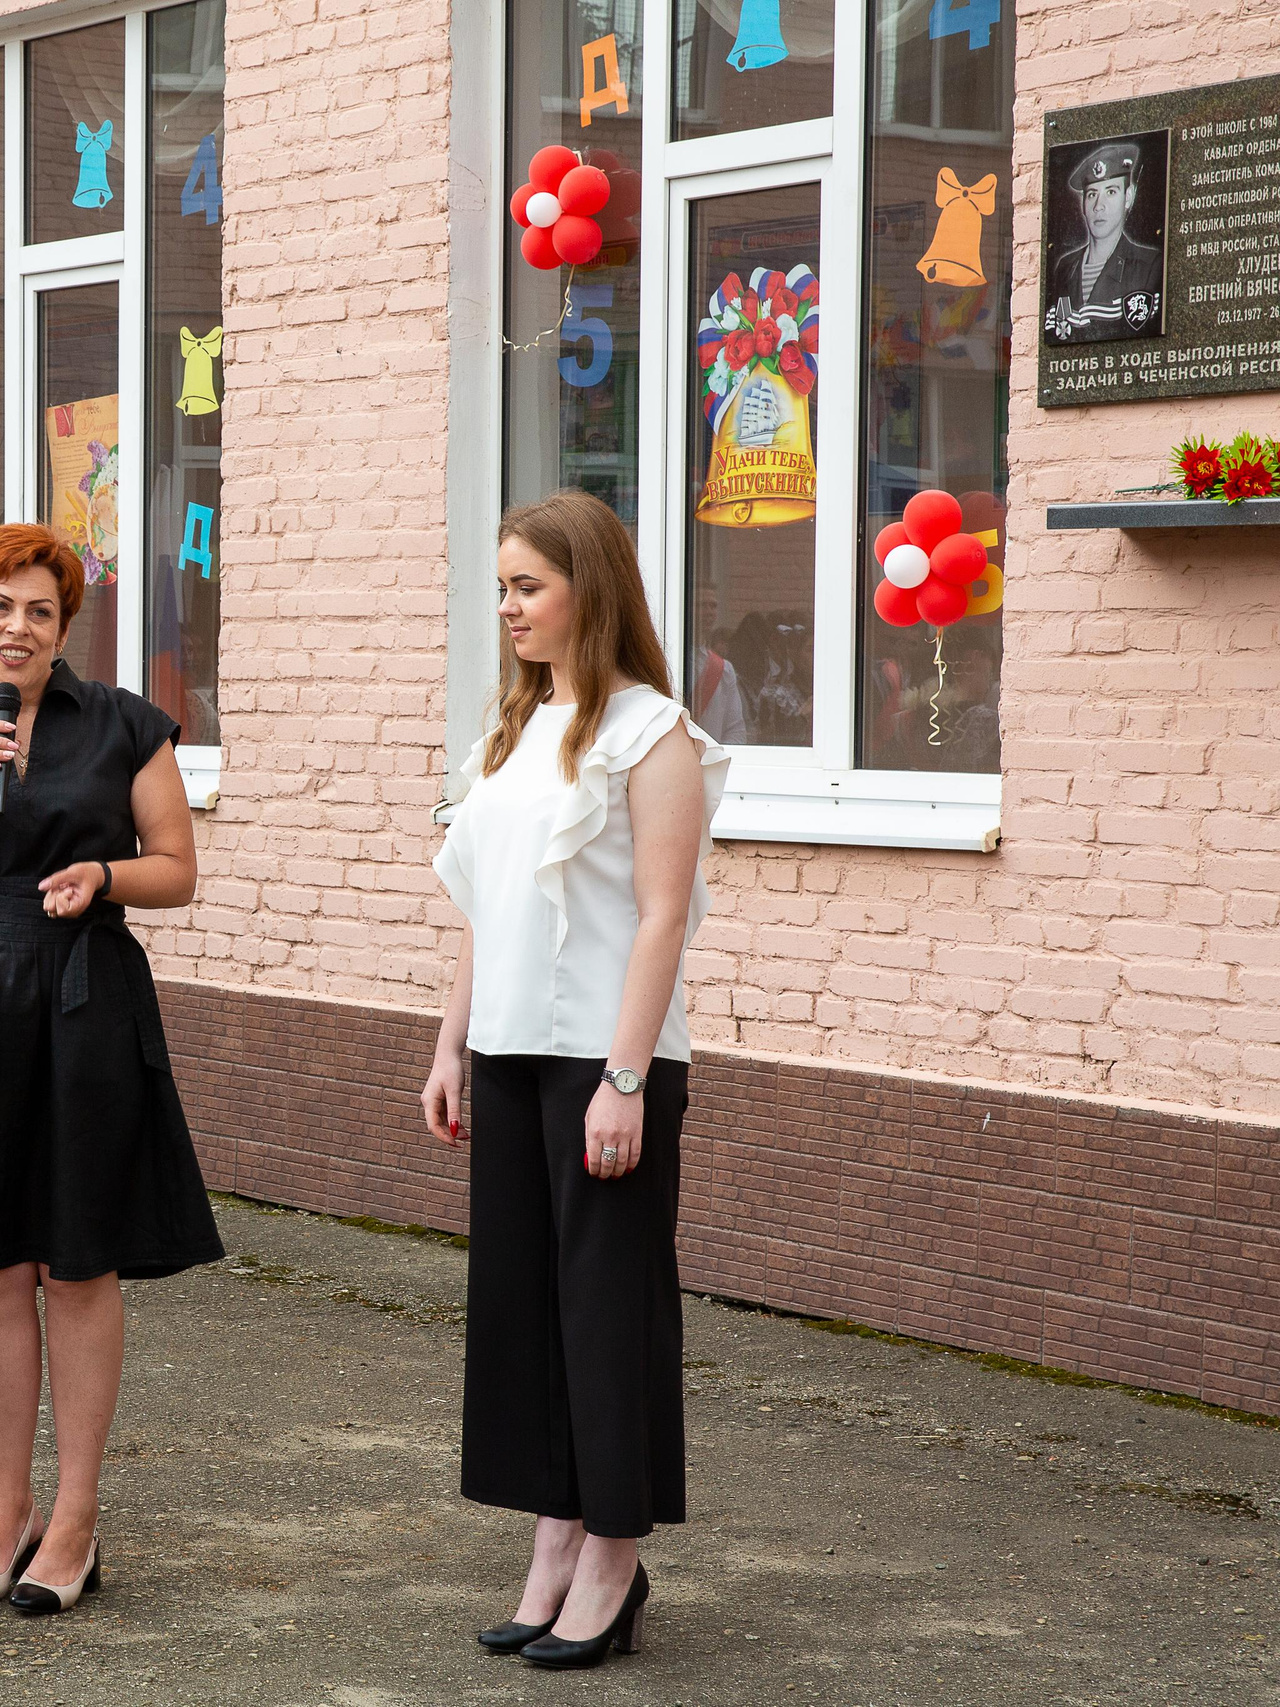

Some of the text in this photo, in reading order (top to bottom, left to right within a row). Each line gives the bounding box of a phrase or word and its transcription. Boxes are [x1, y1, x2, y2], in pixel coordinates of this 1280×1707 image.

[579, 33, 629, 128] Д
[1182, 129, 1188, 141] В
[1190, 122, 1213, 139] ЭТОЙ
[1216, 119, 1247, 136] ШКОЛЕ
[1250, 118, 1256, 130] С
[1204, 144, 1244, 161] КАВАЛЕР
[181, 132, 223, 226] 4
[1192, 167, 1252, 186] ЗАМЕСТИТЕЛЬ
[1188, 185, 1269, 210] МОТОСТРЕЛКОВОЙ
[1179, 221, 1193, 234] 451
[1195, 217, 1225, 233] ПОЛКА
[1186, 244, 1198, 257] ВВ
[1200, 241, 1220, 256] МВД
[1222, 236, 1260, 253] РОССИИ,
[1189, 277, 1280, 303] ЕВГЕНИЙ ВЯЧЕ
[1217, 308, 1262, 325] (23.12.1977
[557, 285, 613, 388] 5
[1049, 340, 1280, 373] ПОГИБ В ХОДЕ ВЫПОЛНЕНИЯ
[1056, 372, 1118, 391] ЗАДАЧИ
[1124, 371, 1133, 384] В
[1140, 360, 1233, 383] ЧЕЧЕНСКОЙ
[707, 472, 816, 501] ВЫПУСКНИК!
[178, 502, 214, 579] Д
